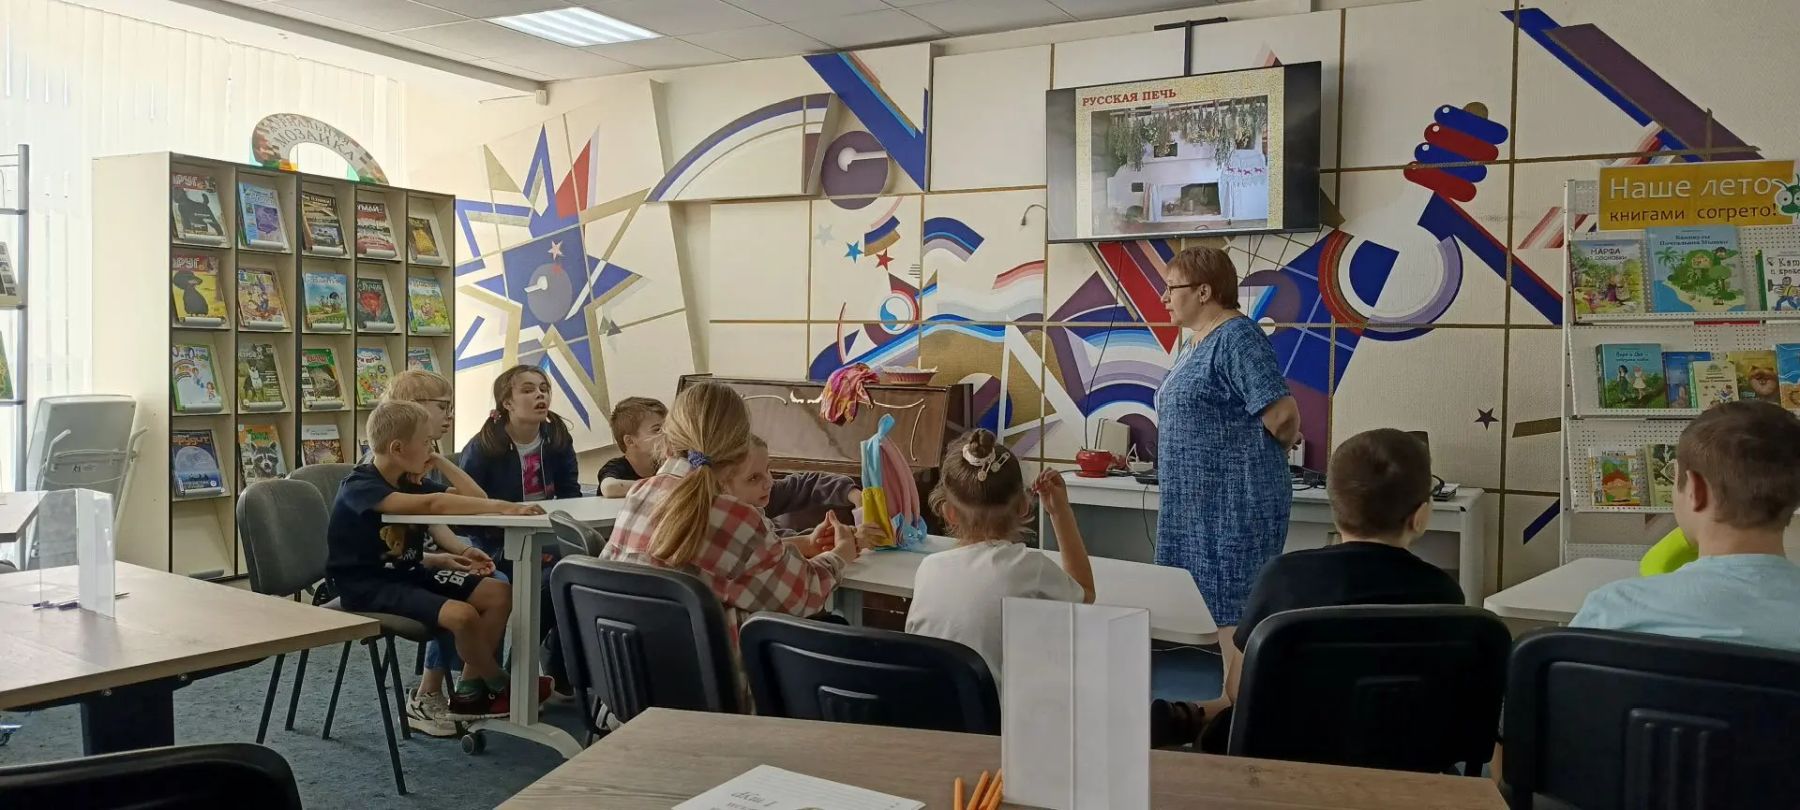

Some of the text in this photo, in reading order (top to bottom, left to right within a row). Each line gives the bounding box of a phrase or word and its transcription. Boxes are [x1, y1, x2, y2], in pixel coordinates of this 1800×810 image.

[1082, 89, 1176, 106] РУССКАЯ ПЕЧЬ
[1609, 176, 1772, 200] Наше лето
[1609, 203, 1778, 222] книгами согрето!
[1590, 247, 1621, 255] МАРФА
